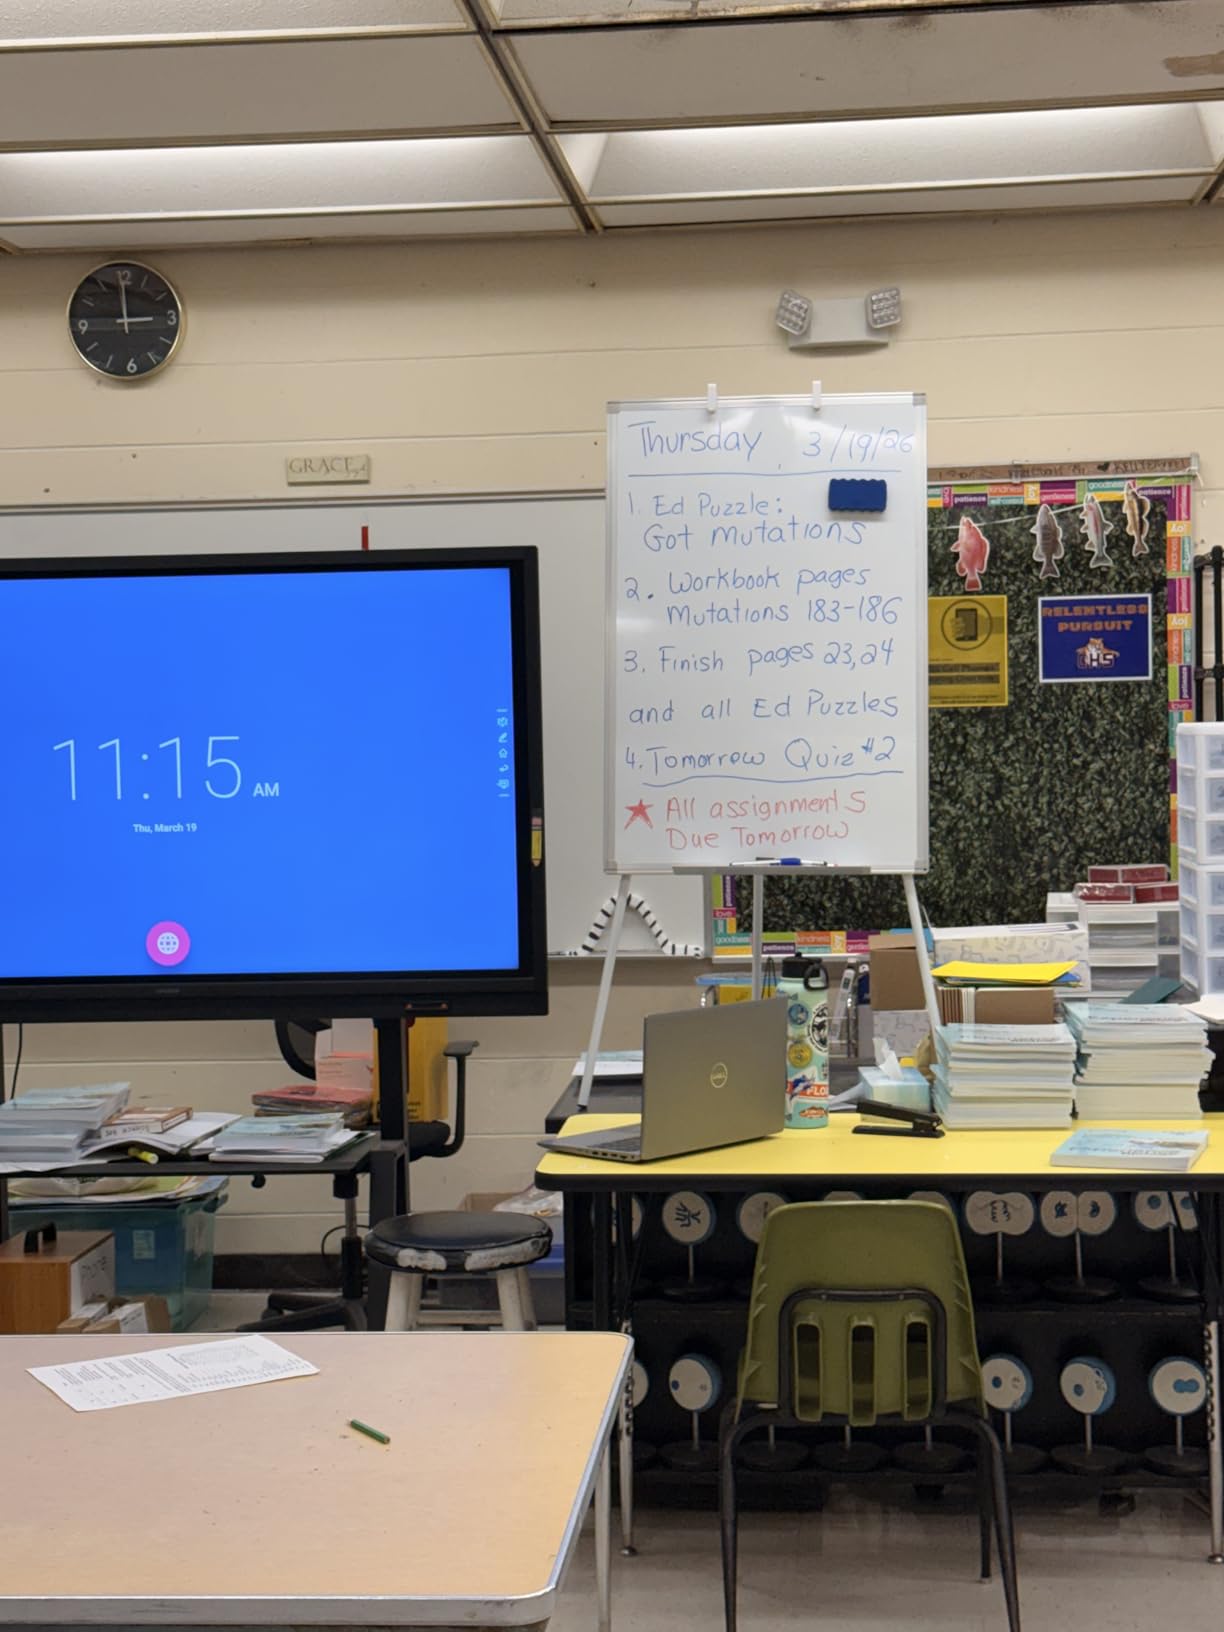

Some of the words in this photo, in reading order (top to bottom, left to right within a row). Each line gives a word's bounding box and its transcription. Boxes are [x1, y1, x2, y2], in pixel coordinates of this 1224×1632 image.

[116, 270, 132, 286] 12
[78, 319, 89, 335] 9
[167, 310, 177, 326] 3
[126, 358, 138, 373] 6
[628, 421, 762, 462] Thursday
[803, 424, 914, 462] 3/19/26
[654, 495, 684, 517] Ed
[700, 491, 782, 517] Puzzle:
[954, 495, 987, 504] patience
[644, 523, 693, 552] Got
[624, 578, 654, 601] 2.
[668, 566, 780, 595] Workbook
[797, 567, 871, 595] pages
[808, 596, 903, 625] 183-186
[1058, 620, 1134, 632] PURSUIT
[624, 650, 646, 673] 3.
[659, 645, 724, 673] Finish
[749, 642, 814, 676] pages
[629, 700, 674, 724] and
[701, 698, 731, 720] all
[753, 695, 791, 718] Ed
[807, 689, 899, 718] Puzzles
[53, 736, 241, 800] 11:15
[253, 782, 280, 797] AM
[625, 747, 643, 769] 4.
[646, 746, 765, 775] Tomorrow
[785, 738, 854, 771] Quiz
[861, 736, 896, 761] #2
[666, 797, 695, 822] All
[133, 823, 153, 833] Thu,
[154, 823, 184, 832] March
[186, 823, 198, 832] 19
[666, 828, 719, 850] Due
[731, 821, 849, 847] Tomorrow
[762, 943, 795, 953] patience
